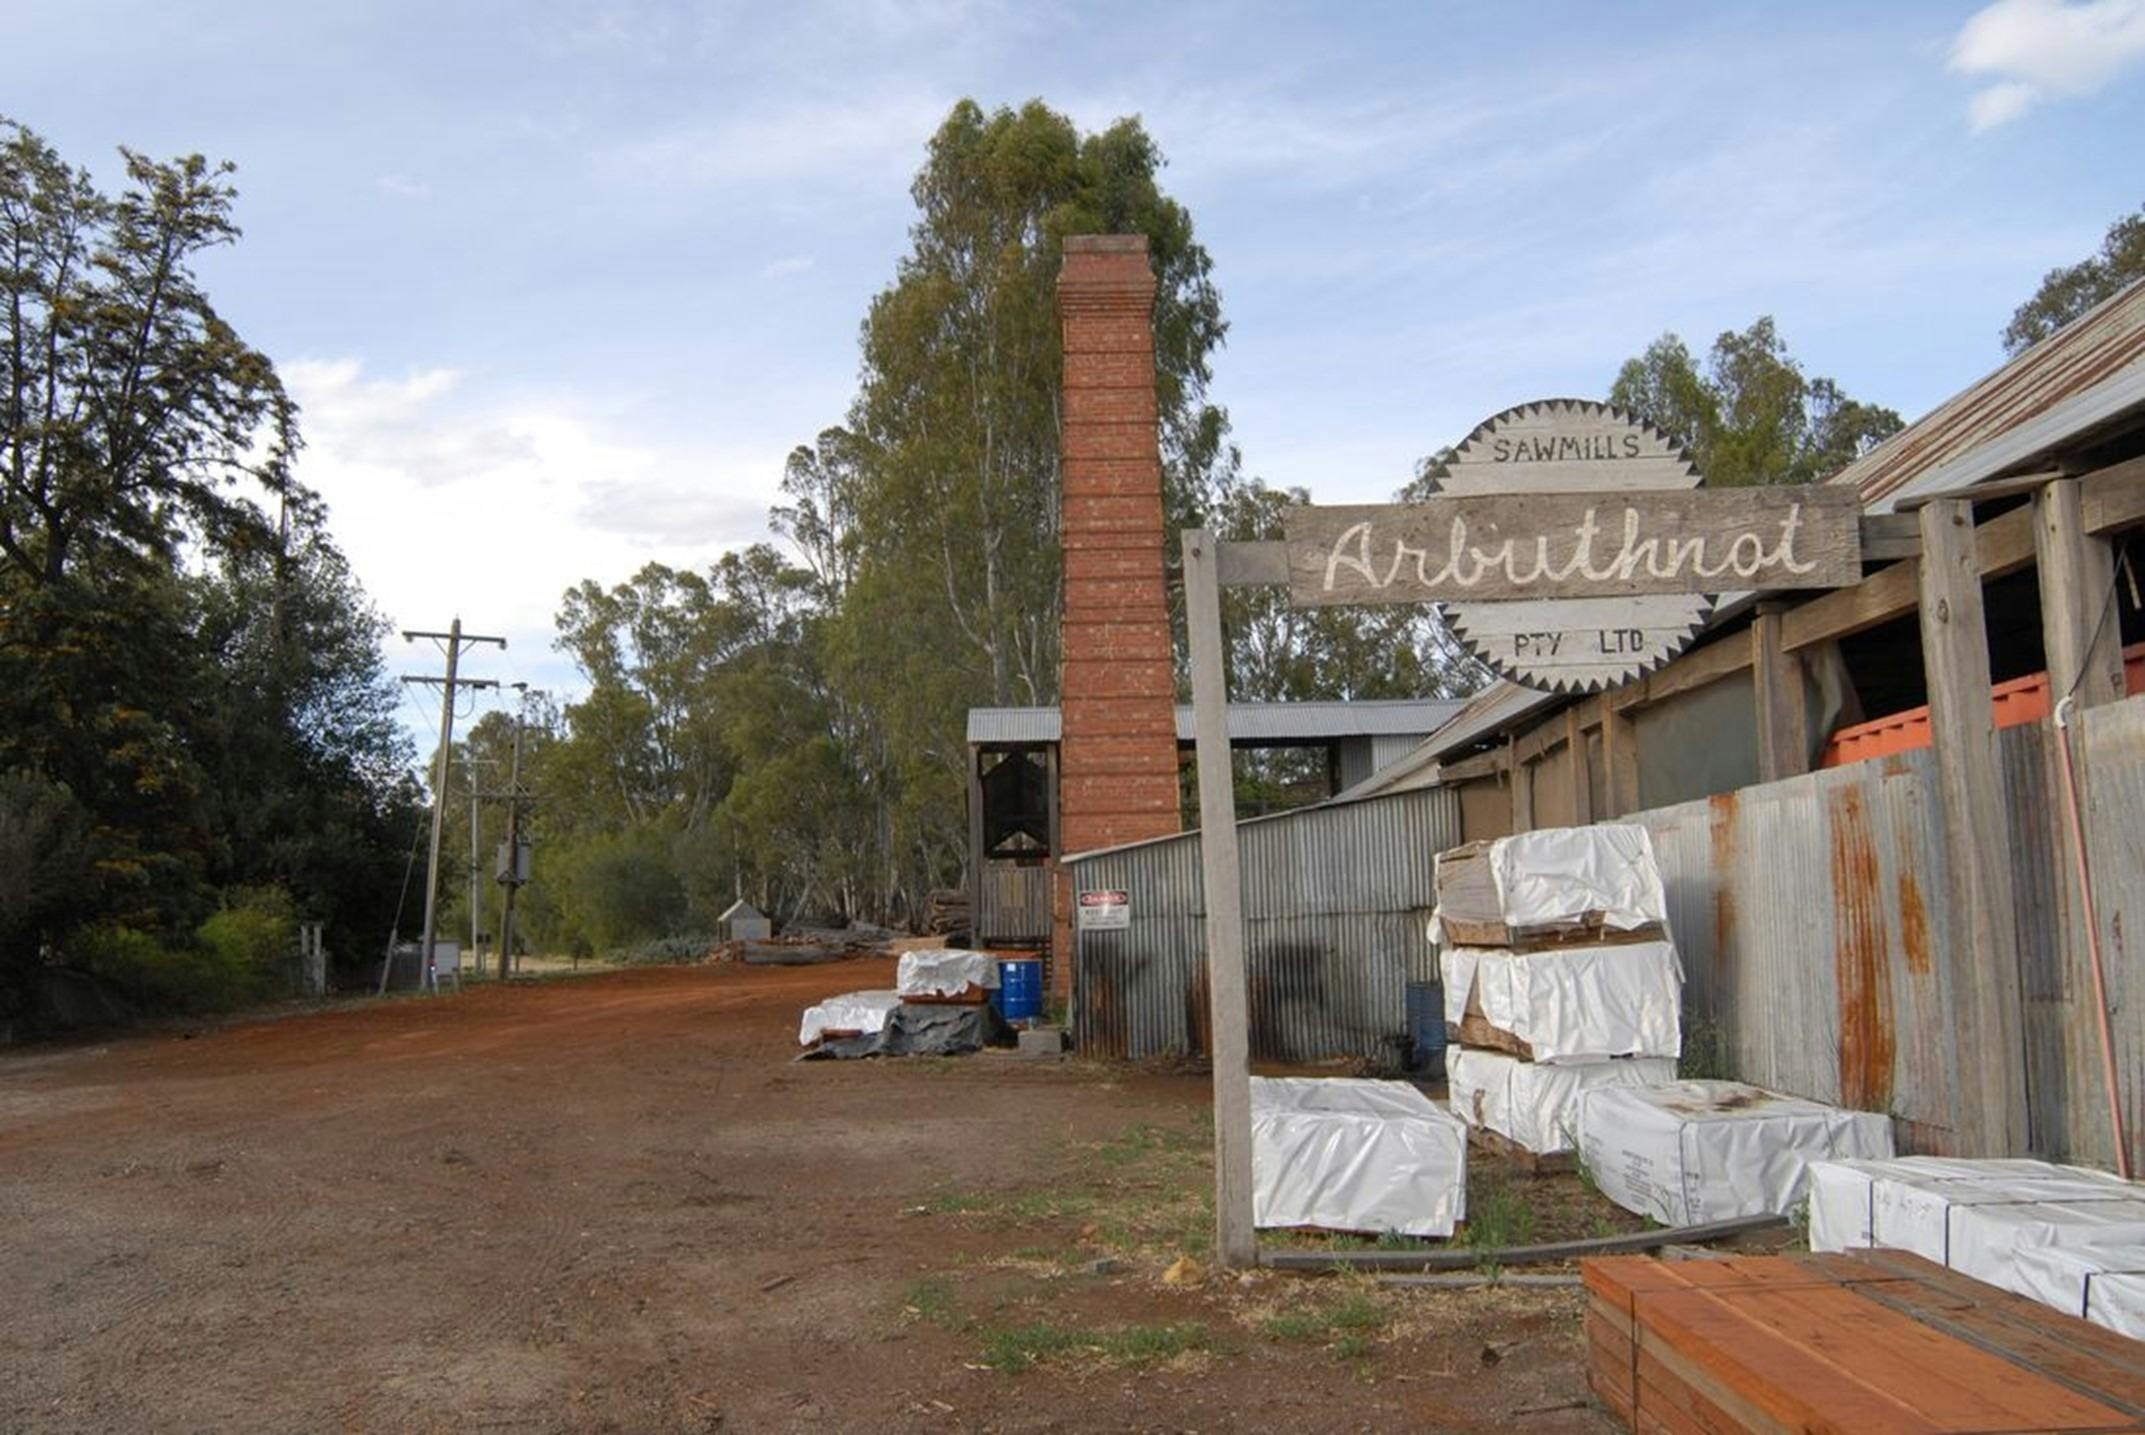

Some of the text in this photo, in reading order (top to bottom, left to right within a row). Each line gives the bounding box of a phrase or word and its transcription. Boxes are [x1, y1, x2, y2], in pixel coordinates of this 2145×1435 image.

[1493, 434, 1640, 463] SAWMILLS
[1323, 503, 1818, 591] Arbuthnot
[1514, 629, 1643, 657] PTY LTD
